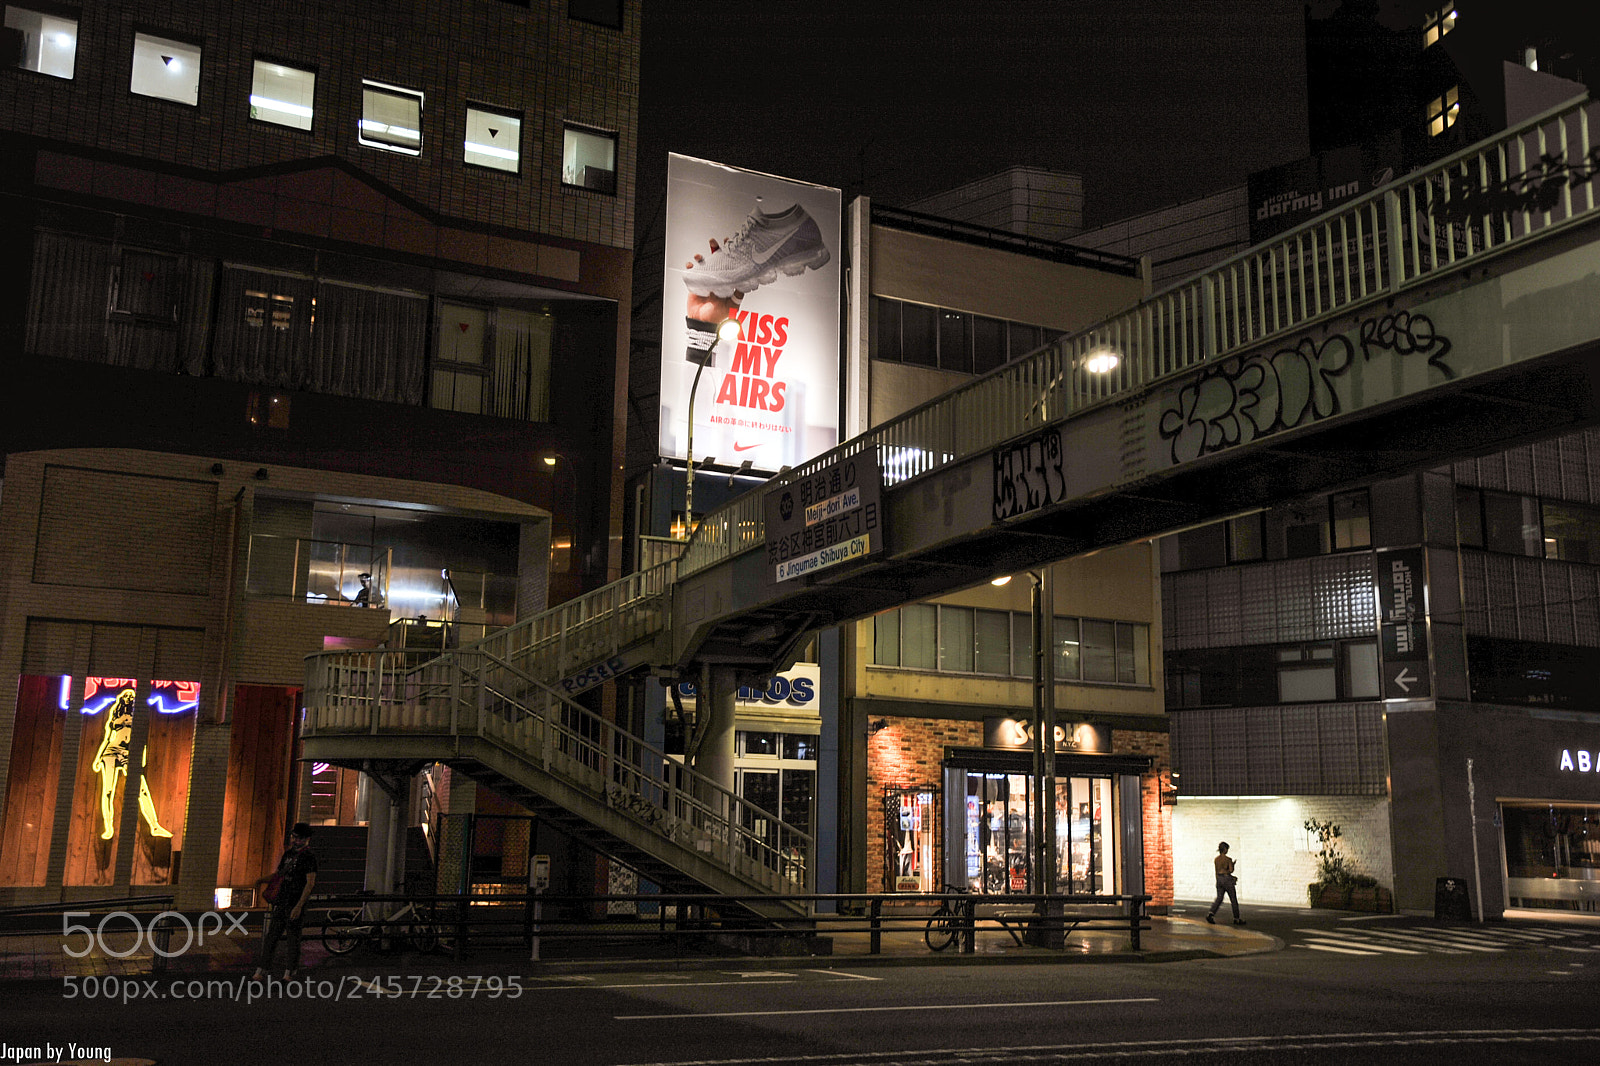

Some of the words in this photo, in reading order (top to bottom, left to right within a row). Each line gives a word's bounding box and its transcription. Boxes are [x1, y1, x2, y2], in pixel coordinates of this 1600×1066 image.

[1257, 191, 1322, 220] dormy
[1329, 181, 1359, 200] inn
[728, 307, 789, 348] KISS
[731, 342, 783, 378] MY
[716, 373, 786, 412] AIRS
[800, 462, 856, 507] 明治通り
[806, 503, 840, 522] Meiji-dori
[843, 494, 859, 509] Ave.
[768, 502, 877, 565] 渋谷区神宮前六丁目
[779, 565, 785, 578] 6
[787, 556, 818, 576] Jingumae
[820, 546, 849, 565] Shibuya
[850, 540, 866, 556] City
[1389, 560, 1410, 621] dormy
[1404, 571, 1413, 601] HOTEL
[1396, 625, 1409, 653] inn
